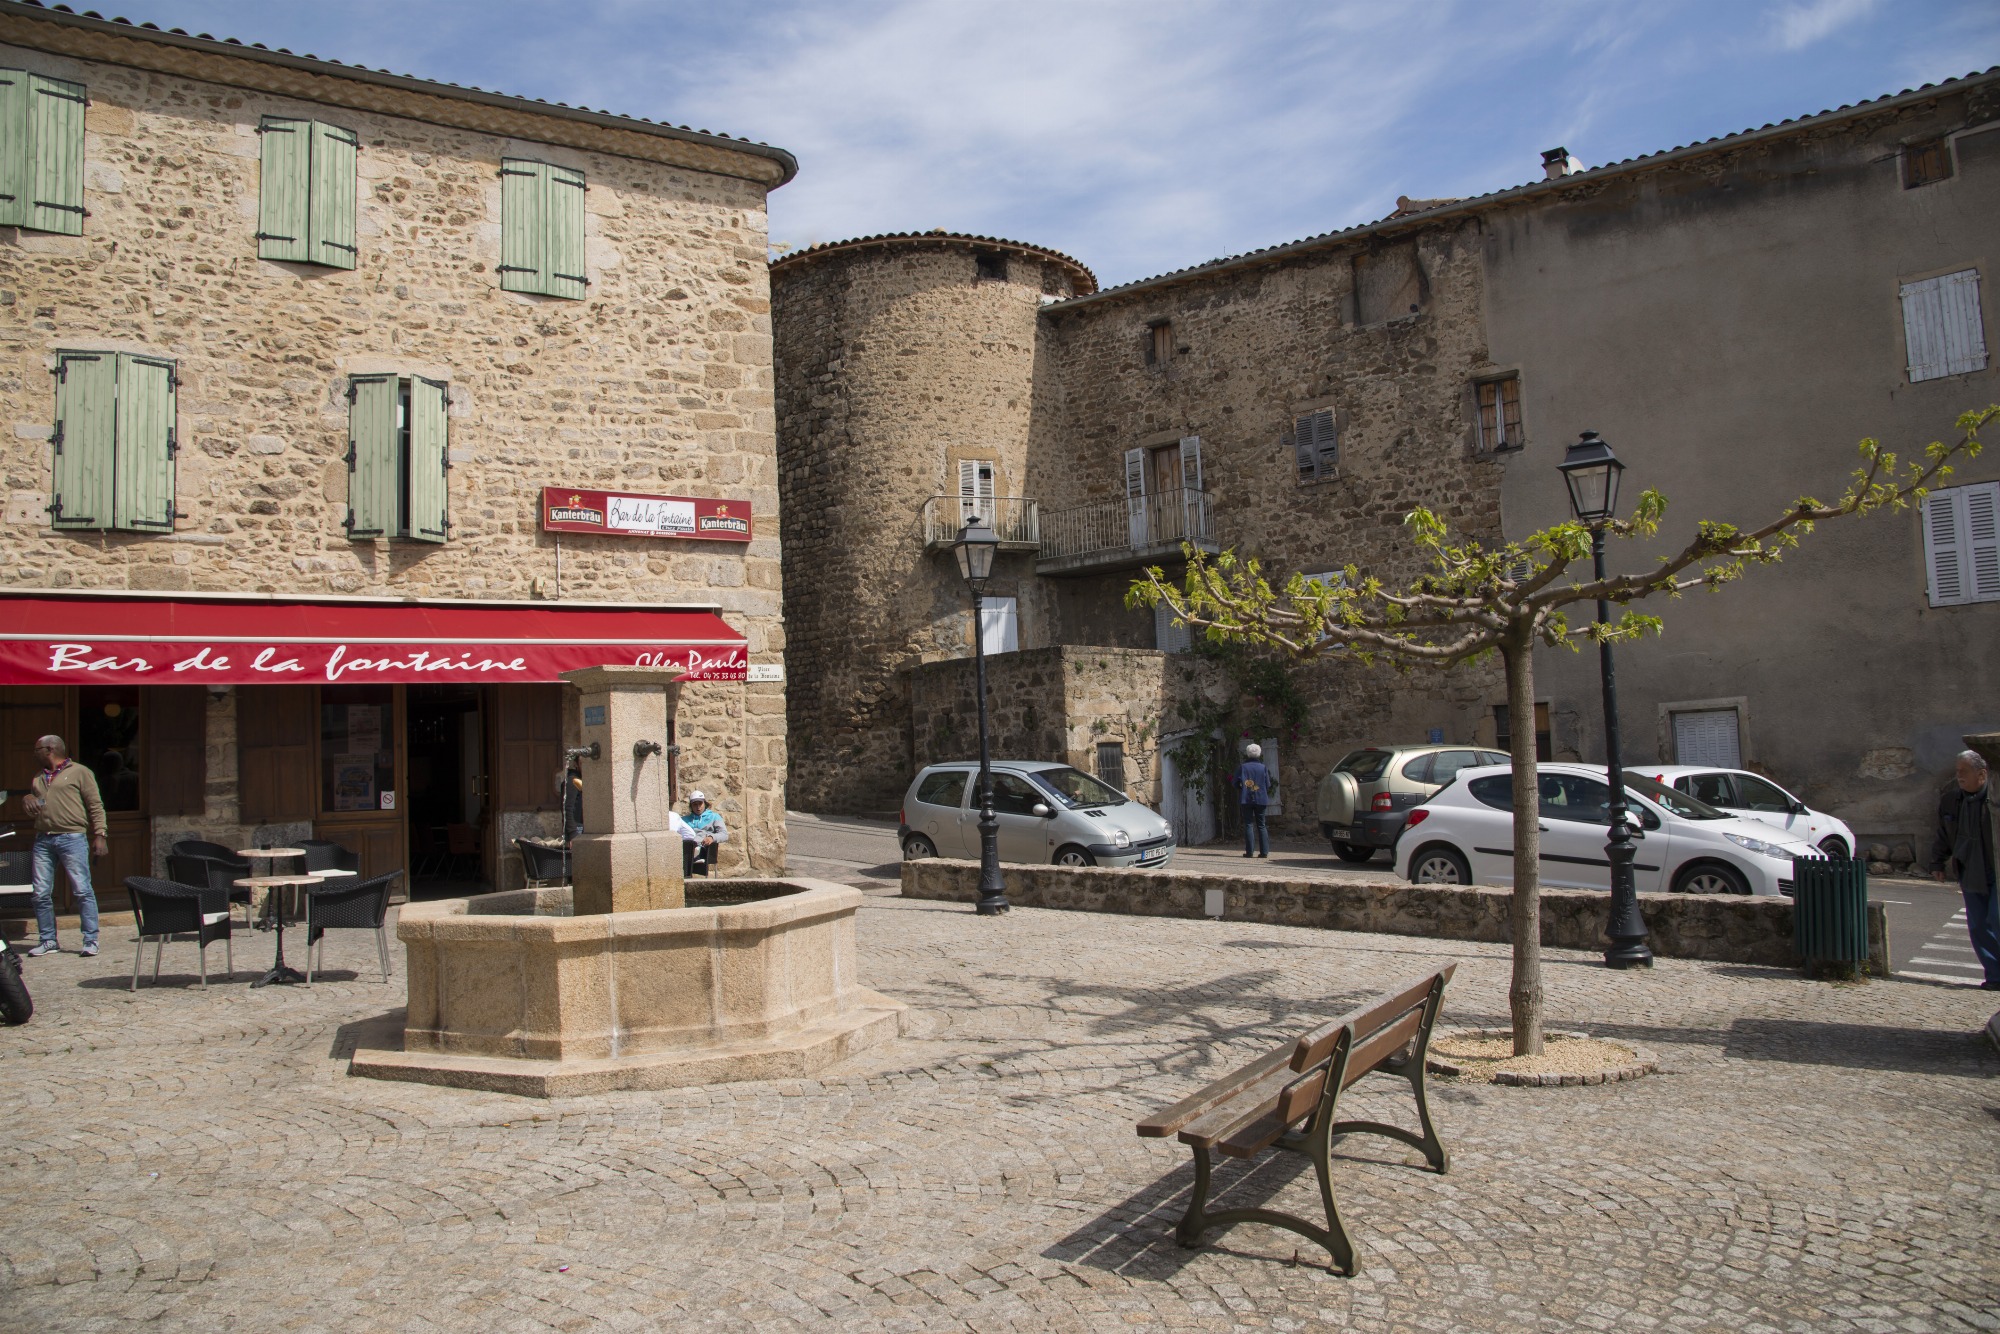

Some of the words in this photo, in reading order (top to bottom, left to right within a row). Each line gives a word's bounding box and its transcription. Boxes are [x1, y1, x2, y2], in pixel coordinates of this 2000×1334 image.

[551, 509, 601, 523] Kanterbräu
[610, 498, 631, 528] Bar
[632, 503, 643, 523] de
[645, 503, 656, 523] la
[657, 502, 693, 530] Fontaine
[701, 518, 747, 531] Kanterbräu
[47, 643, 153, 672] Bar
[173, 647, 231, 672] de
[250, 647, 305, 672] la
[325, 645, 527, 681] fontaine
[687, 650, 747, 670] Paulo
[721, 672, 729, 680] 33
